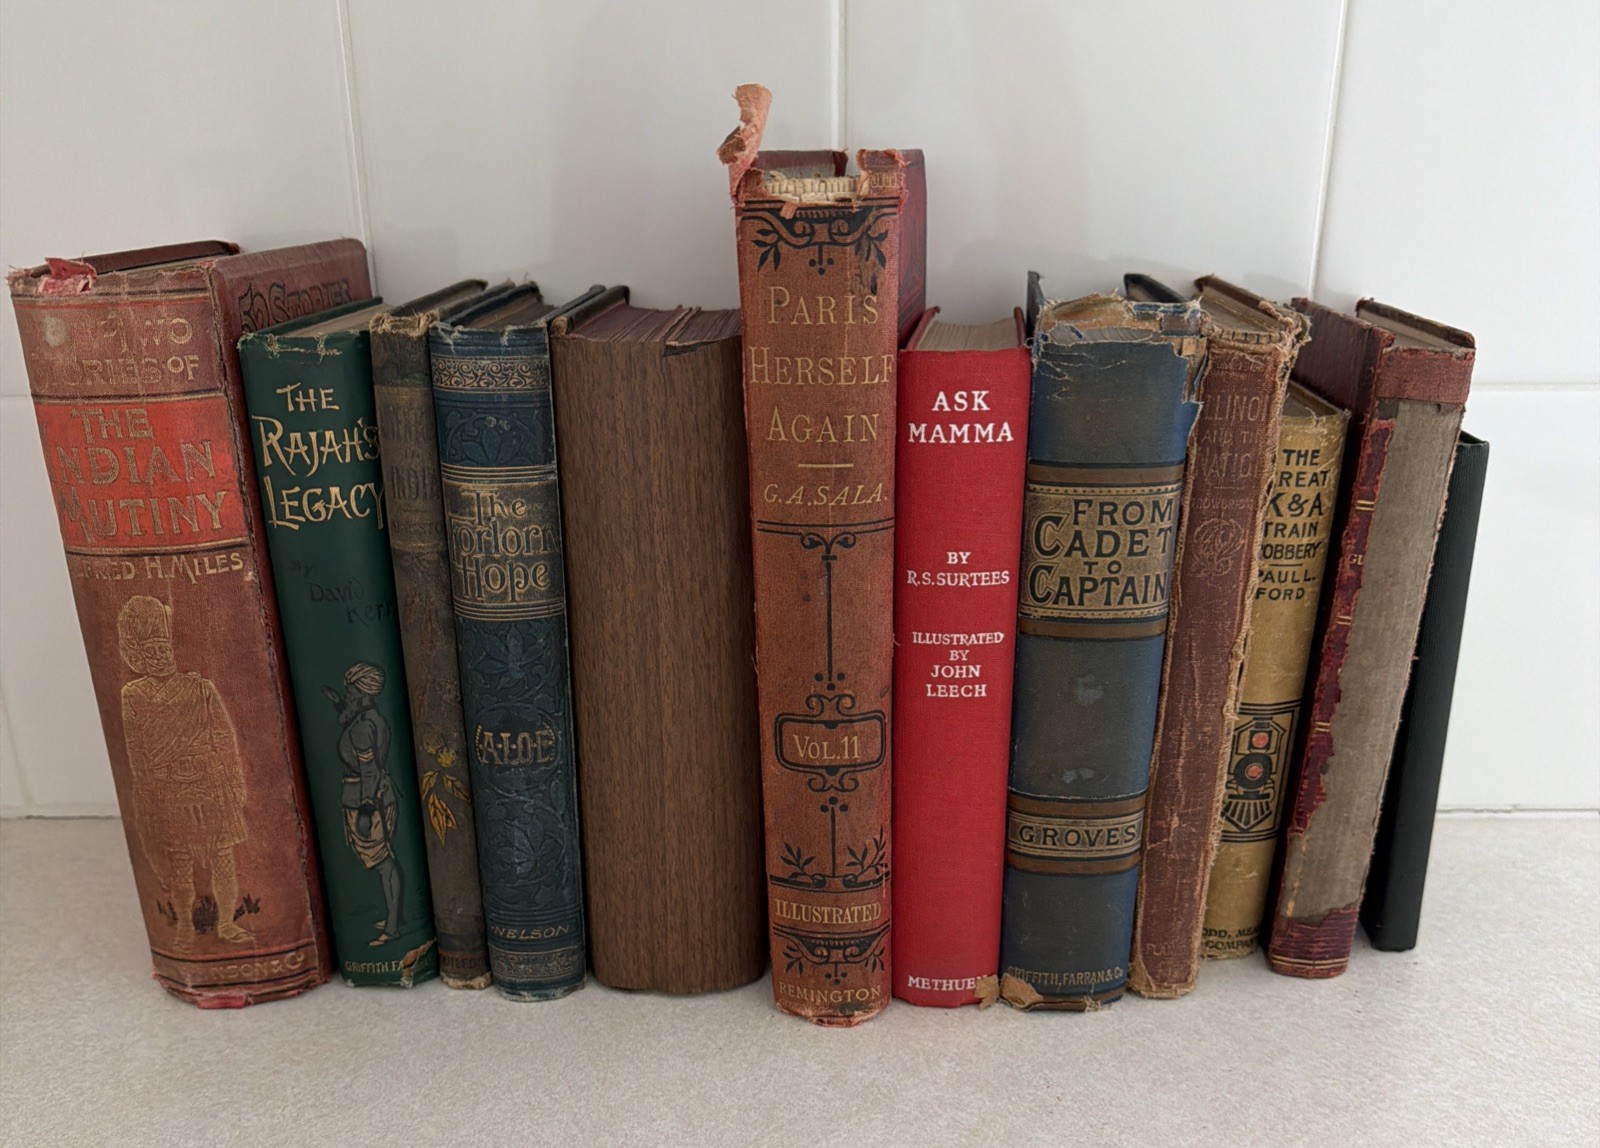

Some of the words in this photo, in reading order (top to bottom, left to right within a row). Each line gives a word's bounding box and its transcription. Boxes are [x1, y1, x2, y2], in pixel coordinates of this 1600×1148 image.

[767, 285, 880, 325] PARIS
[166, 354, 200, 381] OF
[749, 345, 894, 386] HERSELF
[276, 382, 341, 412] THE
[932, 390, 991, 412] ASK
[70, 407, 154, 444] THE
[766, 405, 880, 443] AGAIN
[908, 422, 1014, 443] MAMMA
[252, 414, 381, 478] RAJAH'S
[1282, 448, 1321, 467] THE
[52, 440, 216, 485] NDIAN
[1276, 469, 1331, 488] REAT
[57, 486, 228, 545] MUTINY
[264, 476, 384, 531] LEGACY
[460, 490, 529, 526] The
[1072, 498, 1174, 526] FROM
[1034, 512, 1174, 559] CADET
[1262, 521, 1319, 538] TRAIN
[946, 551, 971, 565] BY
[1258, 541, 1322, 560] OBBERY
[453, 556, 551, 602] Hope
[1084, 560, 1122, 576] TO
[1028, 559, 1170, 607] CAPTAIN
[1254, 587, 1305, 601] FORD
[912, 631, 1005, 646] ILLUSTRATED
[949, 650, 969, 661] BY
[930, 664, 982, 678] JOHN
[926, 683, 987, 698] LEECH
[1019, 822, 1138, 848] GROVES
[774, 899, 881, 925] ILLUSTRATED
[493, 924, 570, 940] NELSON
[344, 960, 389, 973] GRIFFITH
[779, 984, 882, 1006] REMINGTON
